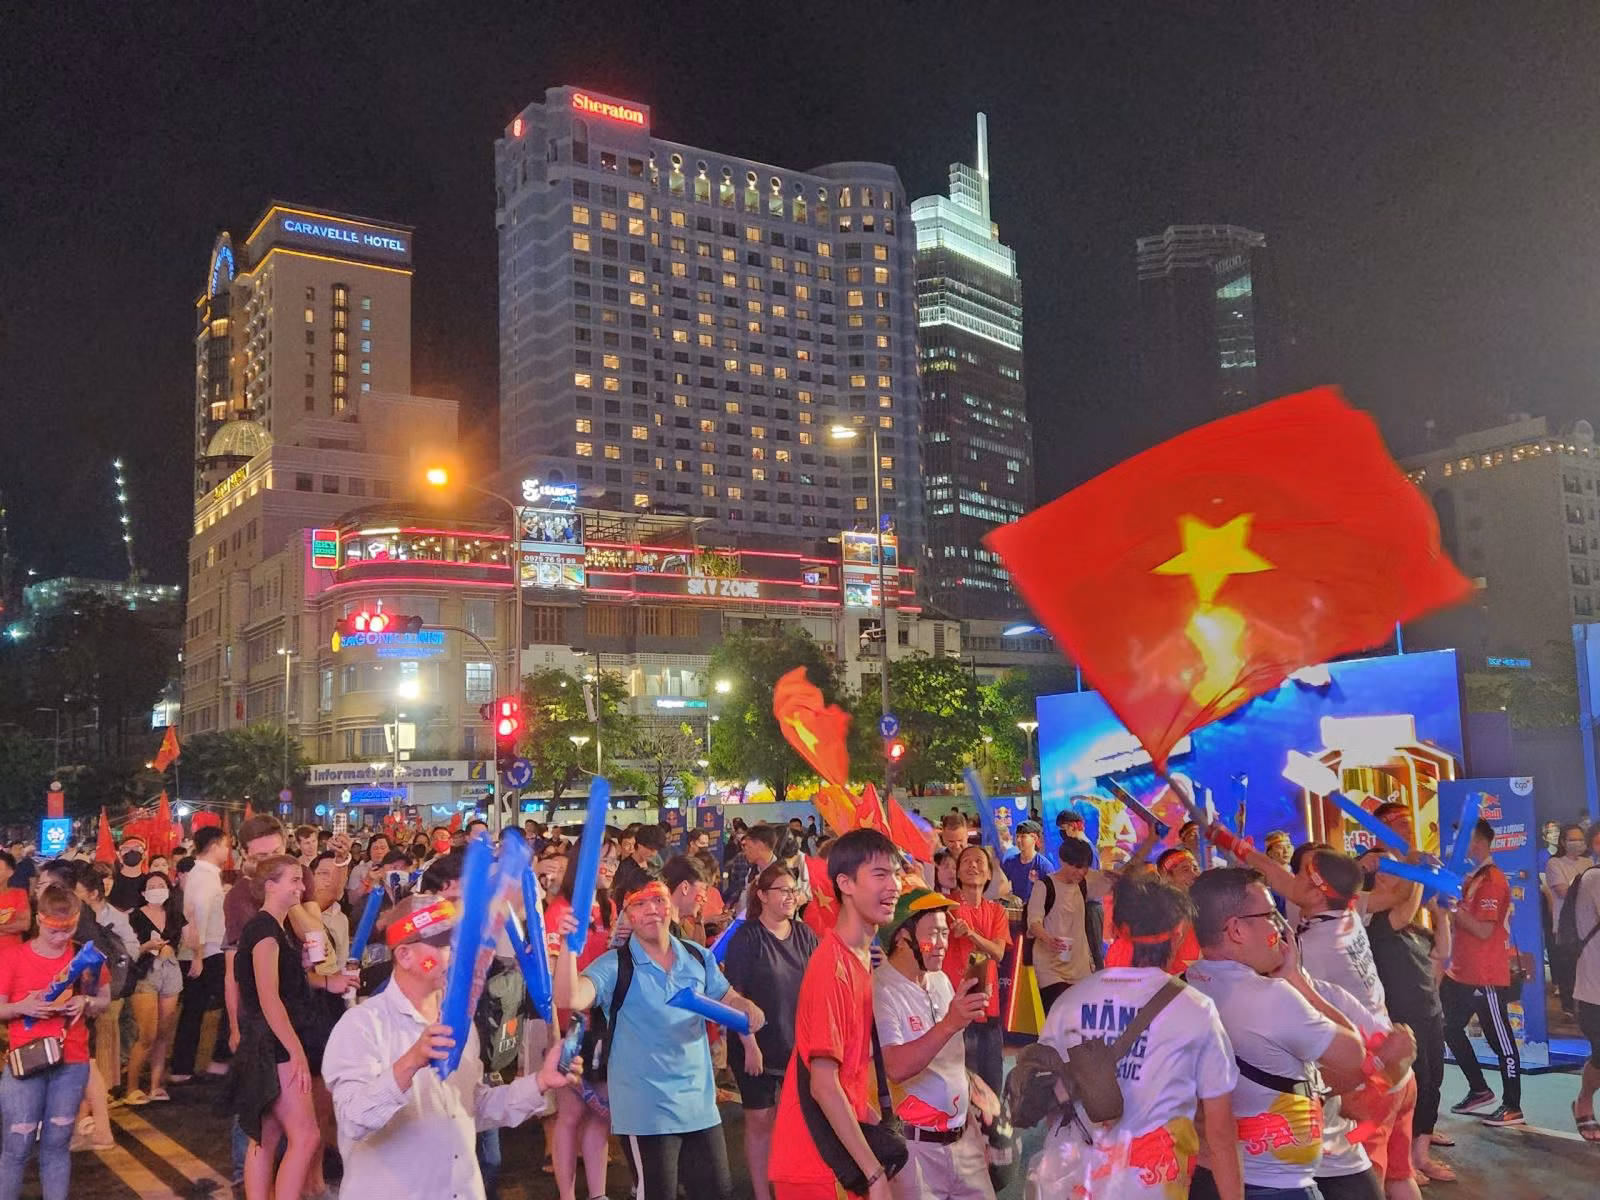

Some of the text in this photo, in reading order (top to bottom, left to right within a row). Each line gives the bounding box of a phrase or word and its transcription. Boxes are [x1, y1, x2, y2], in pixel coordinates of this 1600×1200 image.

[572, 93, 643, 124] Sheraton
[284, 220, 405, 252] CARAVELLE HOTEL
[687, 579, 760, 598] SKY ZONE
[314, 767, 394, 781] Informaton
[1081, 999, 1150, 1031] NĂN
